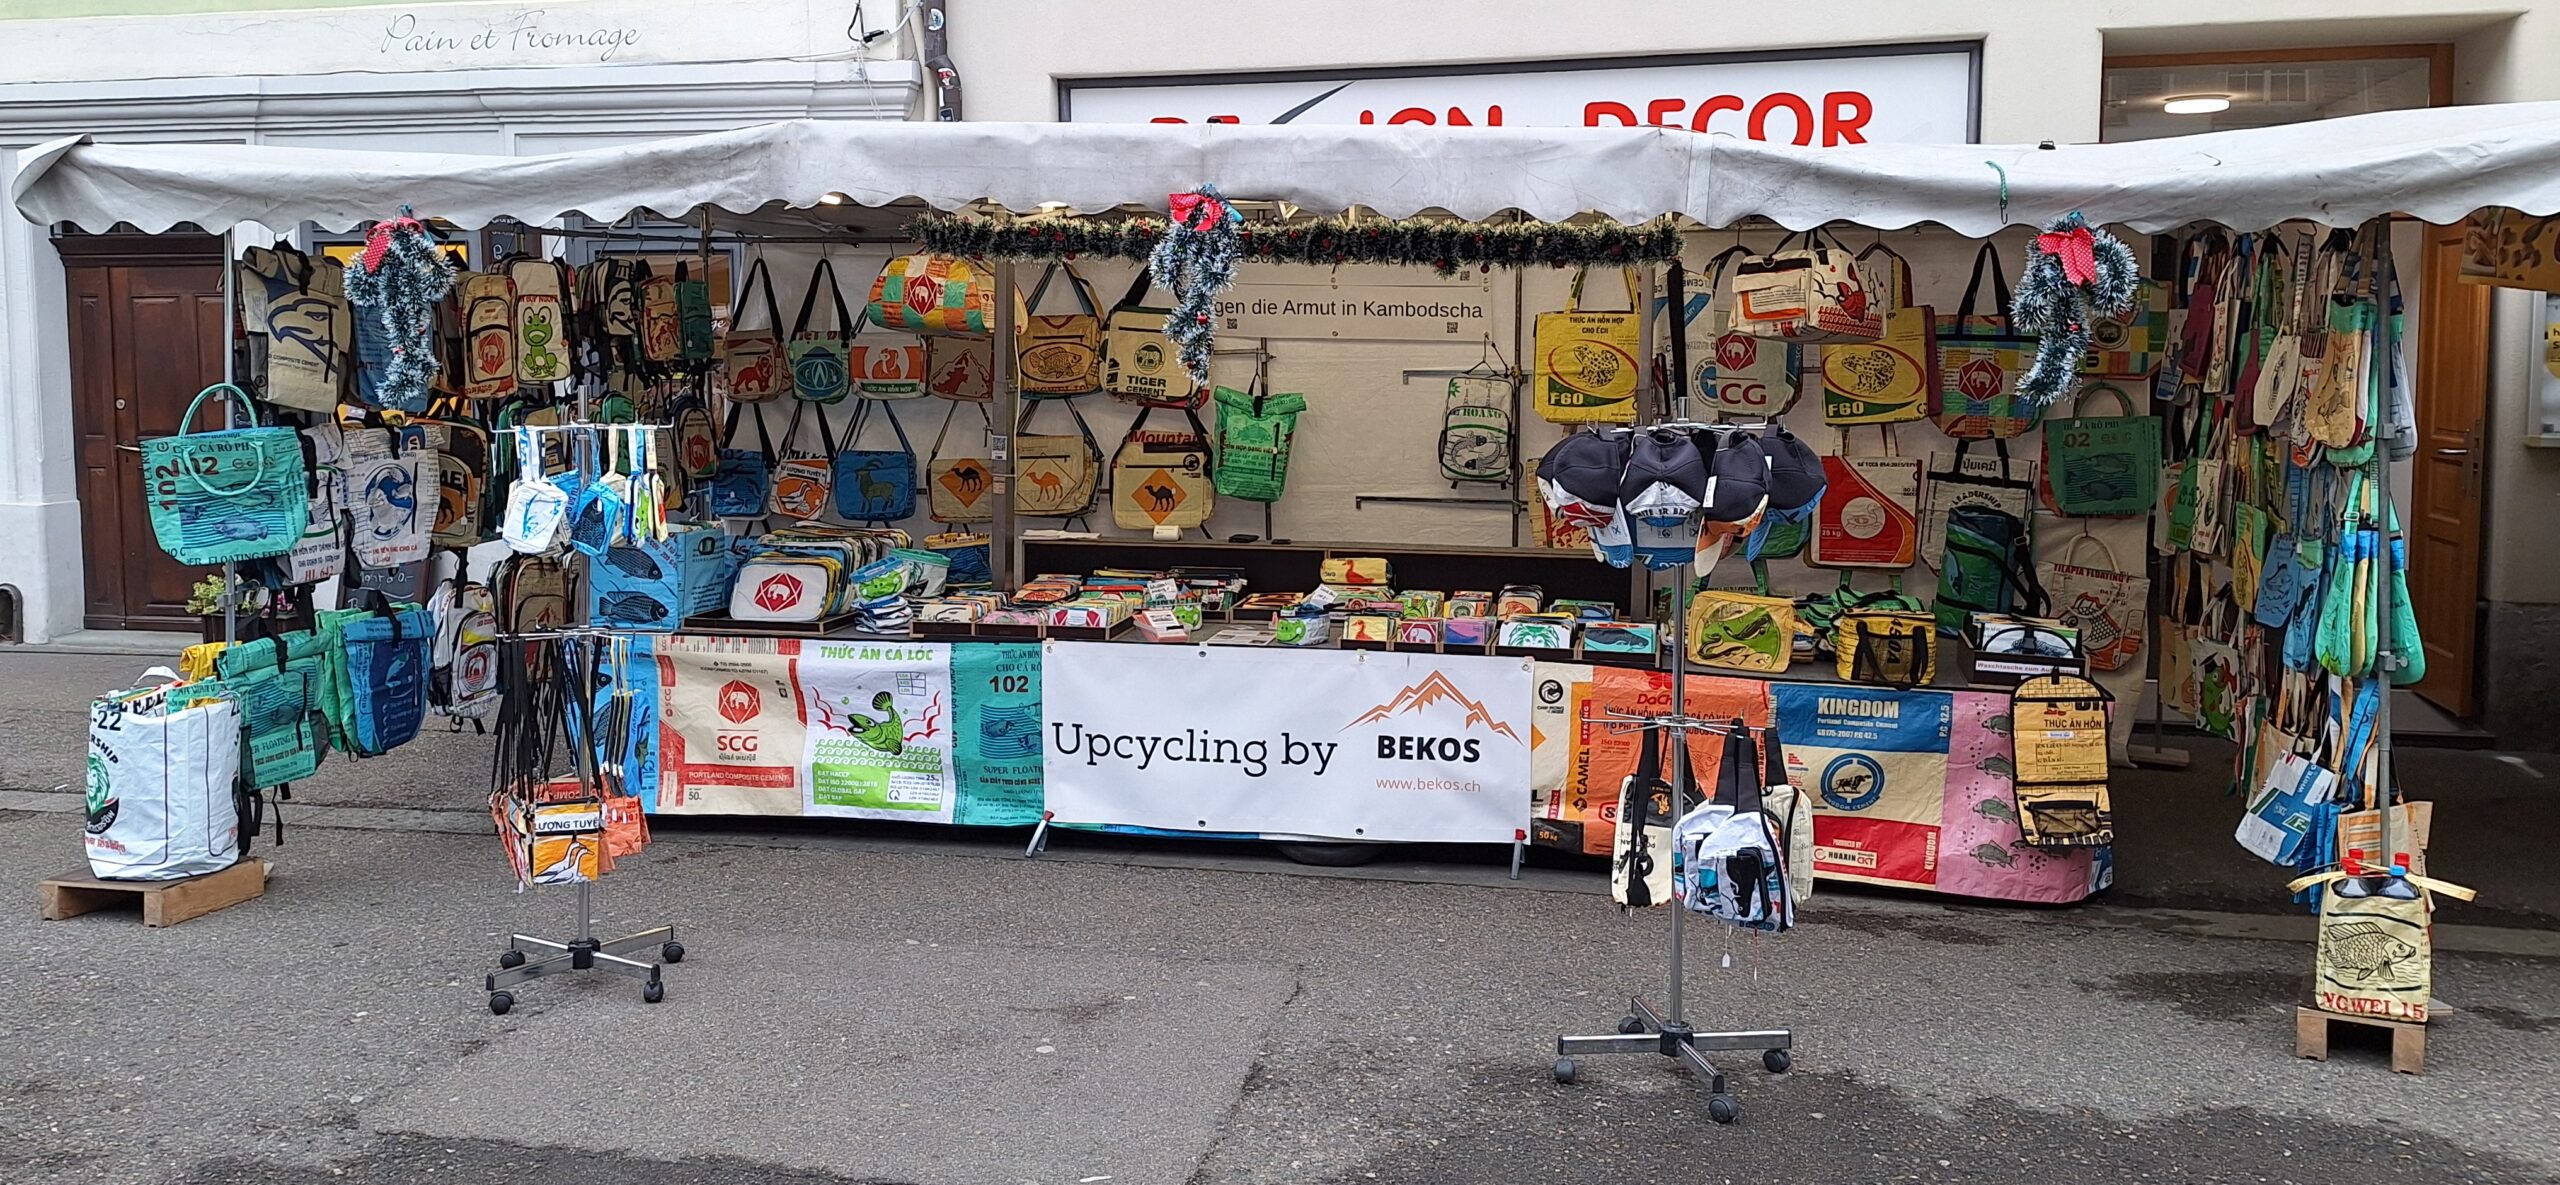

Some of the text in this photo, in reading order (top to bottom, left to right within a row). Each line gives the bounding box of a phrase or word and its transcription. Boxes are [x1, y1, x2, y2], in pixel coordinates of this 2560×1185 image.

[381, 9, 642, 62] Pain et Fromage
[1252, 298, 1278, 315] die
[1282, 299, 1337, 316] Armut
[1341, 300, 1357, 316] in
[1363, 300, 1484, 318] Kambodscha
[1126, 375, 1167, 388] TIGER
[1125, 386, 1166, 397] CEMENT
[1720, 383, 1766, 405] CG
[156, 458, 181, 511] 102
[1952, 490, 2002, 509] LEADERSHIP
[996, 662, 1015, 673] CHO
[1977, 661, 2023, 673] Waschtasche
[989, 675, 1029, 693] 102
[1637, 693, 1692, 706] DaChn
[1818, 696, 1900, 719] KINGDOM
[717, 735, 758, 752] SCG
[1051, 723, 1481, 778] Upcycling by BEKOS
[689, 770, 788, 782] PORTLAND COMPOSITE CEMENT
[983, 765, 1009, 774] SUPER
[1577, 748, 1590, 796] CAMEL
[1374, 775, 1482, 794] www.bekos.ch
[2296, 771, 2314, 794] WHITE
[1539, 831, 1549, 839] 50
[1828, 850, 1857, 863] HUAXIN
[1924, 831, 1937, 871] KINGDOM
[2401, 1001, 2425, 1020] 15
